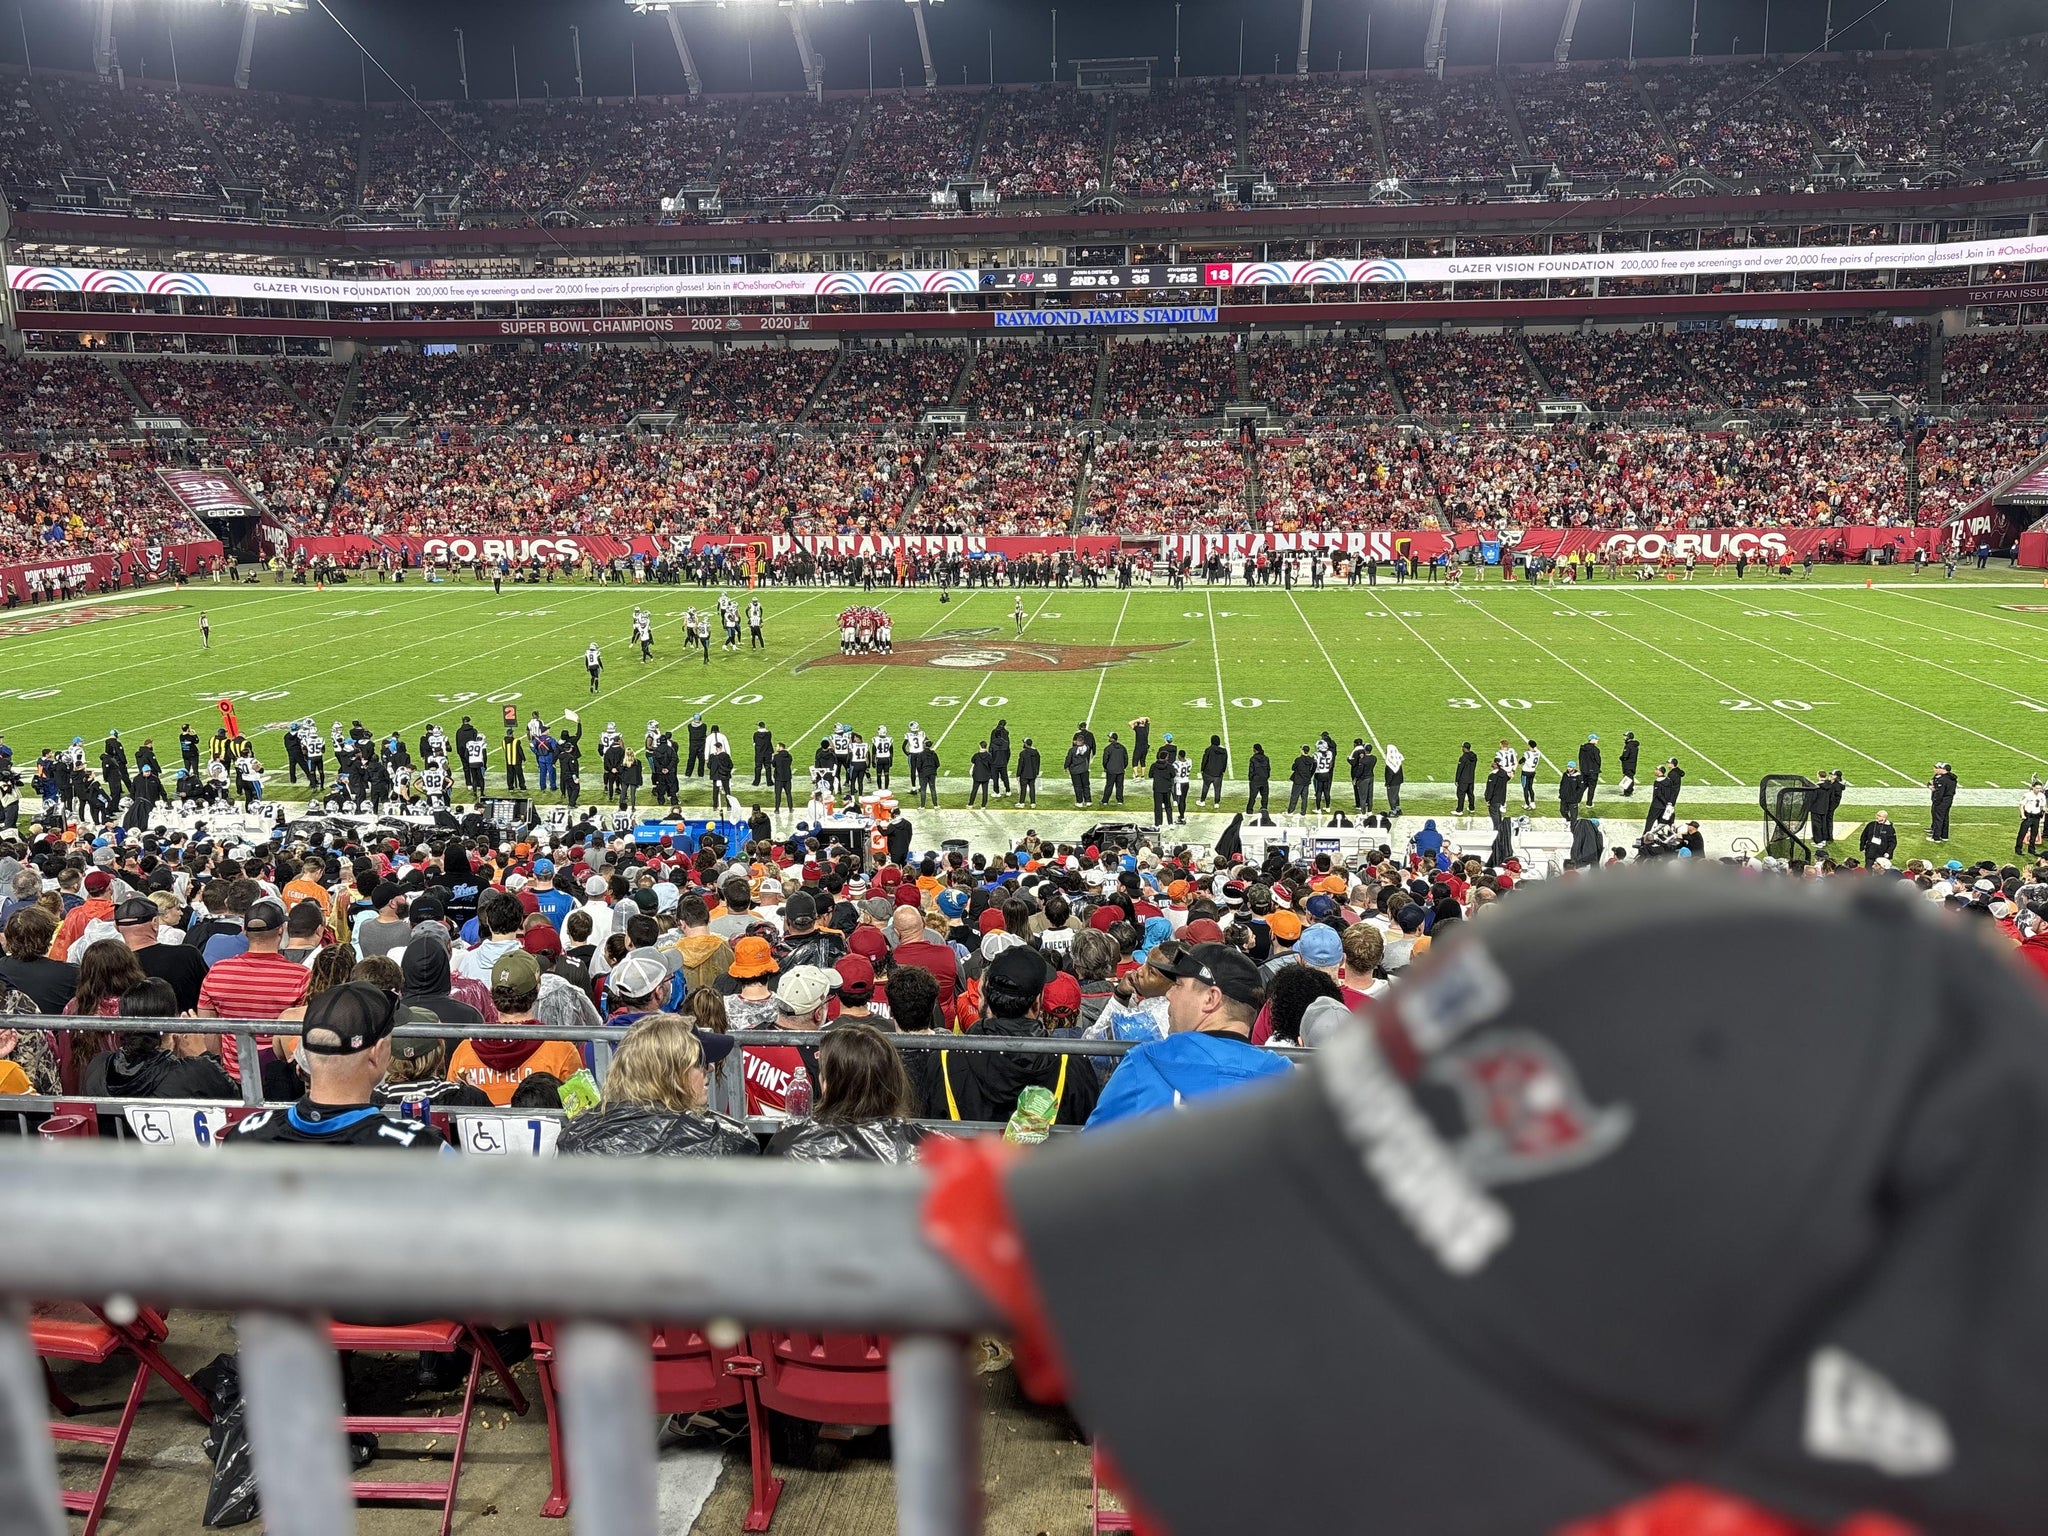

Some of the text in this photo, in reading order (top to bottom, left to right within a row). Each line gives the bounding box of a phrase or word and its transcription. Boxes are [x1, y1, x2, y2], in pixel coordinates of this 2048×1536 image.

[1448, 263, 1492, 274] GLAZER
[1495, 263, 1535, 272] VISION
[1538, 260, 1615, 271] FOUNDATION
[1620, 259, 1659, 270] 200,000
[1660, 258, 1678, 269] free
[1680, 260, 1696, 270] eye
[1697, 257, 1741, 269] screenings
[1744, 256, 1762, 266] and
[1763, 257, 1783, 266] over
[1785, 254, 1819, 266] 20,000
[1820, 253, 1838, 264] free
[1839, 253, 1862, 266] pairs
[1863, 252, 1874, 263] of
[1875, 252, 1926, 265] prescription
[1927, 249, 1963, 264] glasses!
[1965, 248, 1984, 259] Join
[1986, 247, 1995, 257] in
[1006, 273, 1016, 284] 7
[1042, 273, 1057, 283] 16
[1070, 275, 1120, 286] 2ND & 9
[1131, 274, 1150, 284] 38
[1167, 273, 1198, 284] 7:52
[1210, 269, 1229, 281] 18
[253, 280, 806, 298] GLAZER VISION FOUNDATION 200,000 free eye screenings and over 20,000 free pairs of prescription glasses! Join in #OneShareOnePair
[1968, 291, 1995, 300] TEXT
[1996, 290, 2017, 299] FAN
[995, 307, 1217, 326] RAYMOND JAMES STADIUM
[501, 321, 547, 334] SUPER
[550, 321, 590, 333] BOWL
[592, 319, 674, 333] CHAMPIONS
[691, 319, 722, 331] 2002
[760, 317, 792, 330] 2020
[207, 509, 245, 517] GEICO
[423, 538, 580, 562] GO BUCS
[1606, 533, 1786, 559] GO BUCS
[504, 706, 515, 719] 2
[309, 743, 322, 754] 35
[834, 739, 848, 751] 52
[877, 742, 890, 753] 48
[913, 737, 920, 749] 3
[468, 745, 481, 756] 29
[855, 746, 865, 759] 41
[1318, 758, 1331, 770] 55
[1532, 757, 1538, 769] 9
[426, 775, 441, 788] 82
[865, 805, 873, 814] G
[552, 812, 565, 824] 17
[614, 818, 629, 830] 30
[539, 904, 556, 913] LLAN
[1044, 940, 1071, 950] KUECHL
[469, 1067, 533, 1085] MAYFIELD
[742, 1050, 791, 1096] EVANS
[193, 1111, 211, 1148] 6
[527, 1120, 541, 1157] 7
